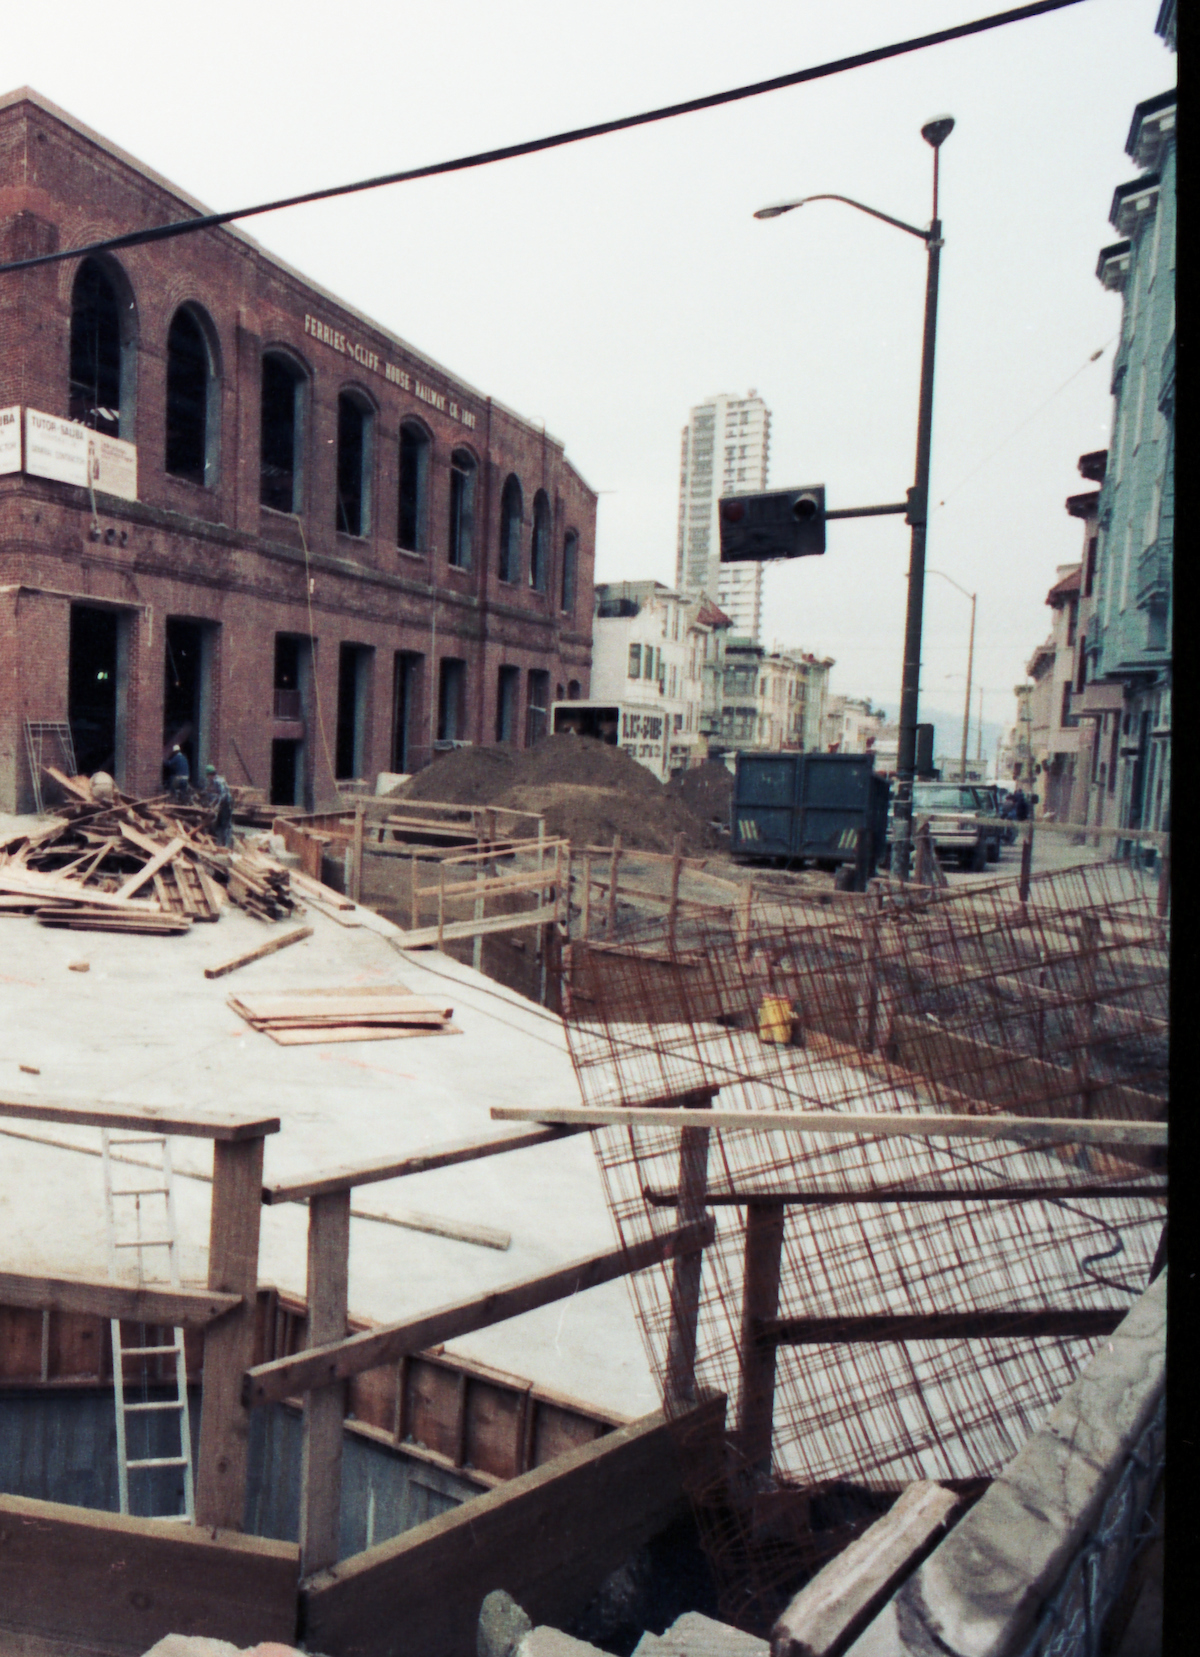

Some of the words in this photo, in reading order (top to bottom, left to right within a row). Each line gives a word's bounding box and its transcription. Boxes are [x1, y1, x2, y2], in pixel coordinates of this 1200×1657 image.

[305, 314, 346, 353] FERRIES
[355, 343, 379, 372] CLIFF
[385, 362, 411, 391] HOUSE
[415, 380, 446, 411] RAILWAY
